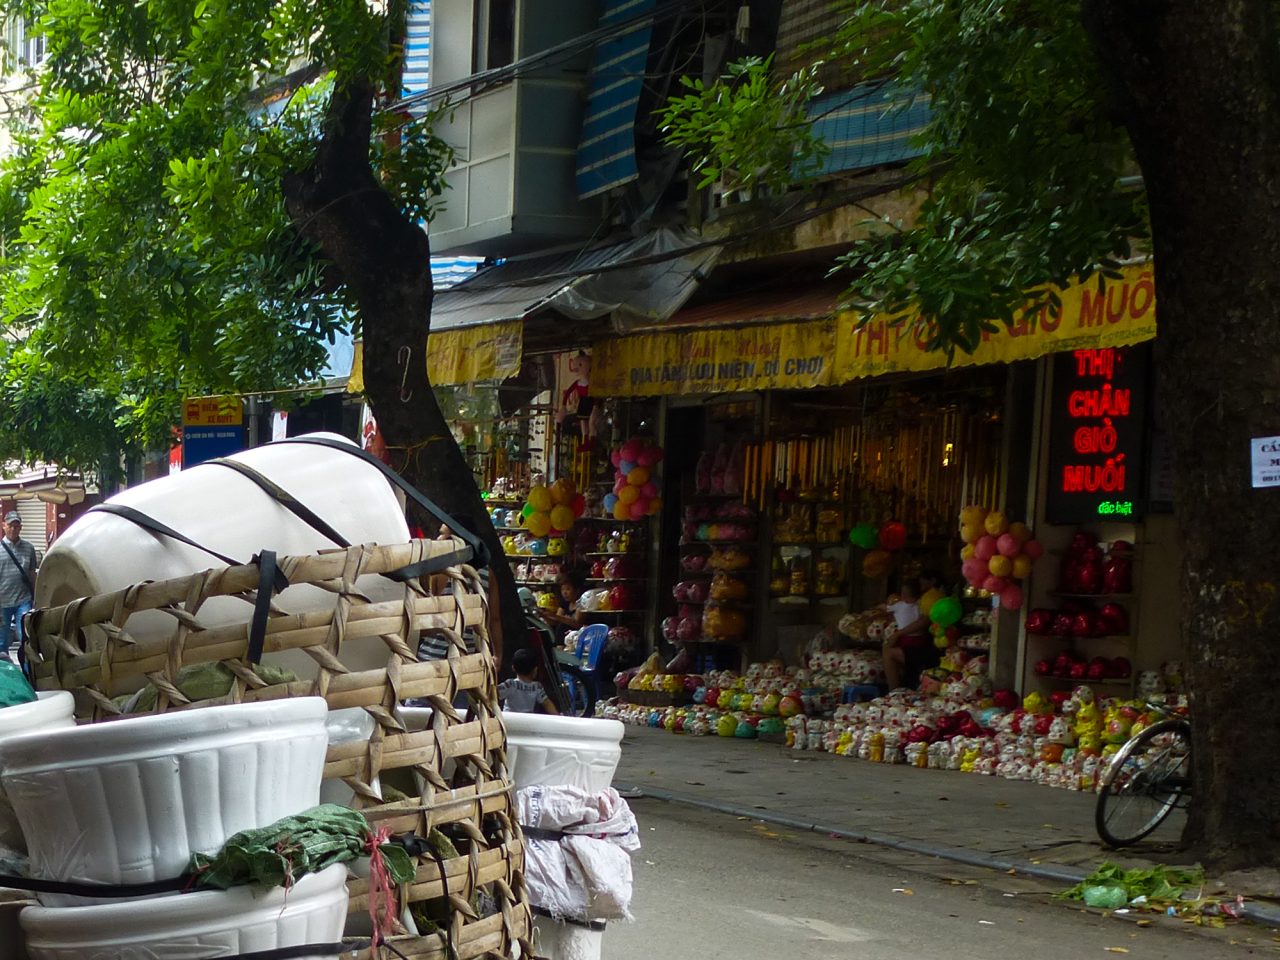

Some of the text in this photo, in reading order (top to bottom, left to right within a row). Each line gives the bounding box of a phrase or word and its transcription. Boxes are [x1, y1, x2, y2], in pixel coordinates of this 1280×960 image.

[1069, 383, 1131, 417] CHÂN
[1074, 417, 1117, 453] GIÒ
[1063, 453, 1126, 492] MUỐI
